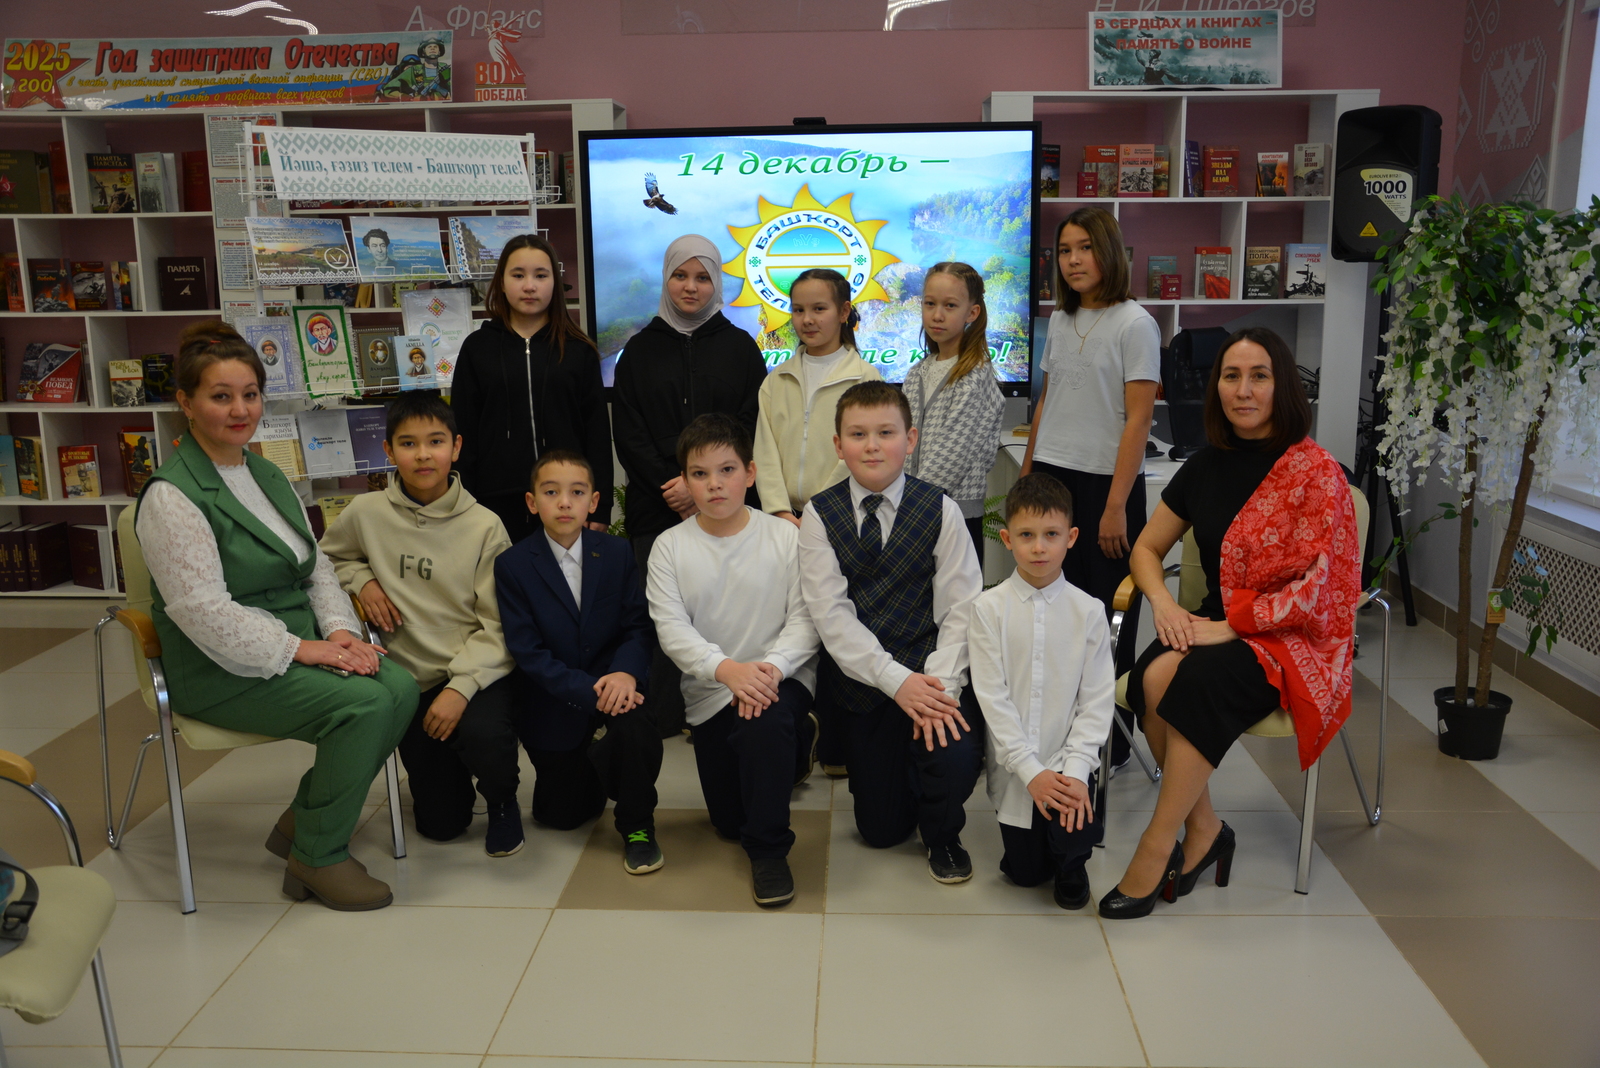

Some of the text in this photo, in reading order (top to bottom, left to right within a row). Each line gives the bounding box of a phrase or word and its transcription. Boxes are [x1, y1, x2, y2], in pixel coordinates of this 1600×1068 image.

[1095, 19, 1105, 29] В
[1109, 18, 1182, 32] СЕРДЦАХ
[1186, 18, 1197, 28] И
[1201, 17, 1262, 28] КНИГАХ
[1116, 35, 1252, 50] ПАМЯТЬ О ВОЙНЕ
[6, 42, 71, 72] 2025
[95, 37, 400, 77] Год защитника Отечества
[18, 72, 54, 93] год
[66, 67, 389, 90] в честь участников специальной военной операции (СВО)
[475, 61, 503, 85] 80
[167, 92, 210, 102] память
[224, 89, 272, 102] подвигах
[275, 88, 299, 100] всех
[301, 86, 346, 103] предков
[475, 89, 528, 101] ПОБЕДА!
[279, 151, 329, 175] Йәшә,
[330, 160, 369, 173] ғәзиз
[371, 160, 414, 174] телем
[490, 160, 524, 175] теле!
[677, 151, 726, 177] 14
[737, 149, 909, 179] декабрь
[1365, 180, 1407, 194] 1000
[755, 213, 863, 250] БАШҠОРТ
[167, 264, 200, 273] ПАМЯТЬ
[754, 274, 790, 311] ТЕЛ
[45, 381, 73, 390] ПОБЕД
[400, 554, 433, 581] FG
